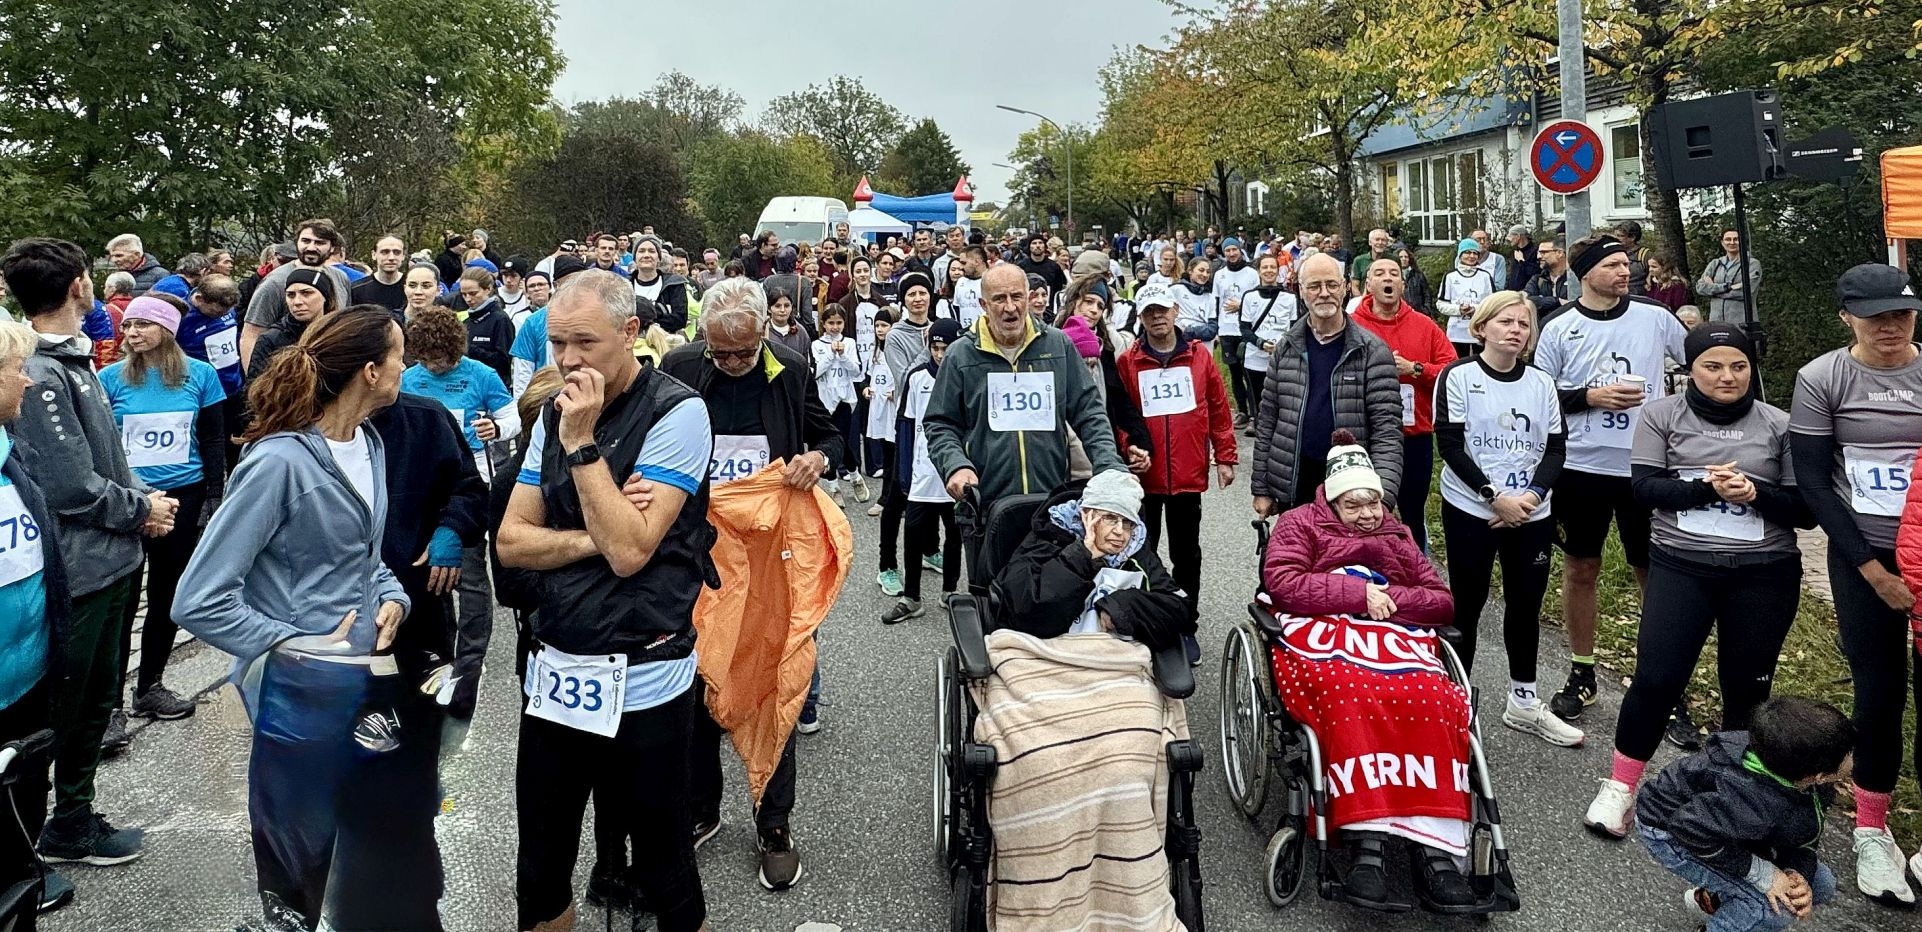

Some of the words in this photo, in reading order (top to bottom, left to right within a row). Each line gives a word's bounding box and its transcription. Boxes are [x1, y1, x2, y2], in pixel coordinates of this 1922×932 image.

[221, 341, 235, 355] 81
[831, 367, 844, 378] 70
[875, 374, 887, 385] 63
[1151, 382, 1183, 400] 131
[1002, 391, 1042, 412] 130
[1602, 411, 1630, 430] 39
[144, 430, 175, 448] 90
[709, 459, 753, 481] 249
[1505, 470, 1529, 489] 43
[1867, 467, 1909, 492] 15
[0, 514, 39, 553] 78
[549, 671, 602, 712] 233
